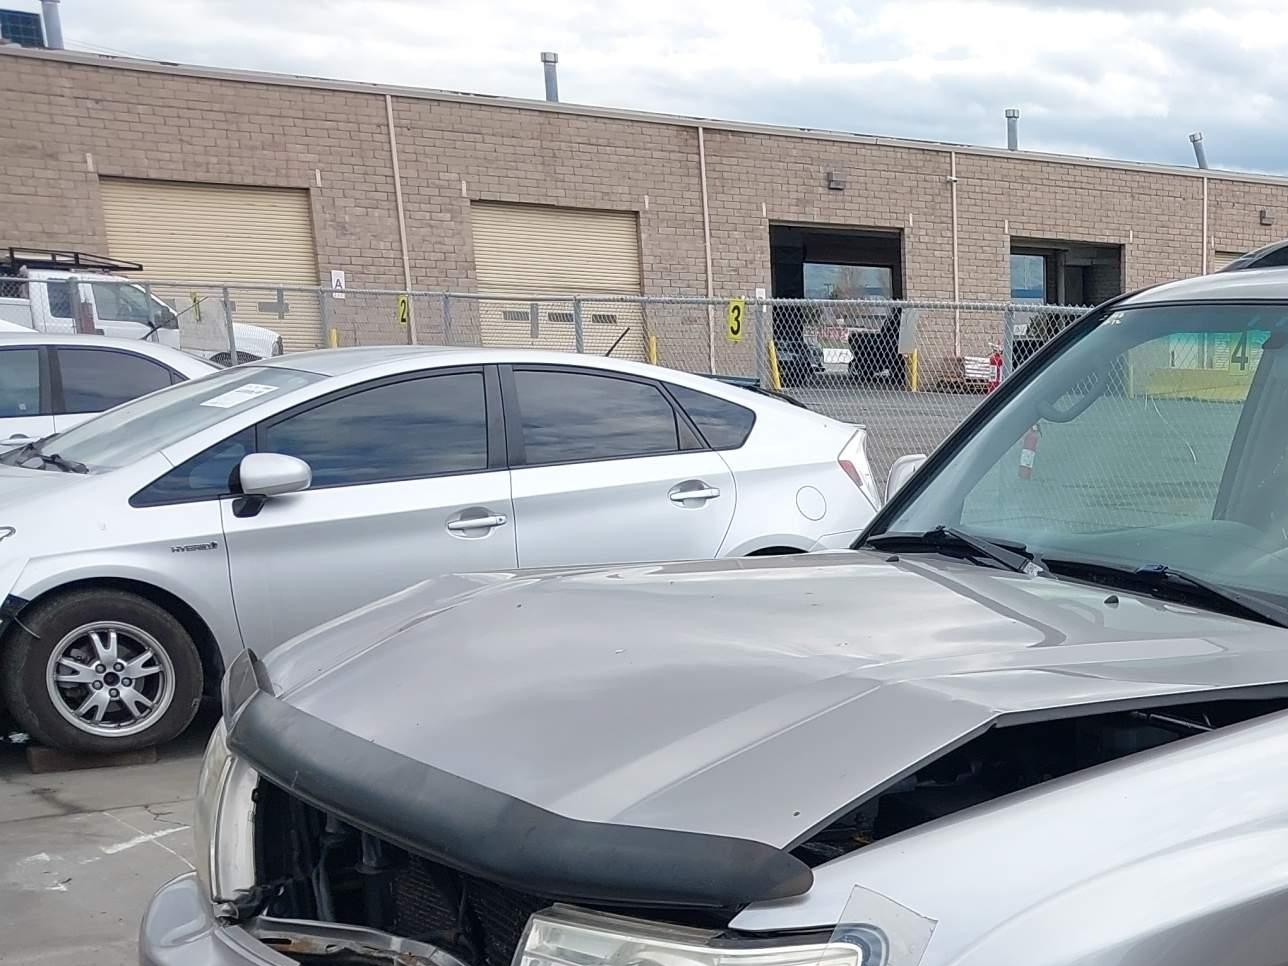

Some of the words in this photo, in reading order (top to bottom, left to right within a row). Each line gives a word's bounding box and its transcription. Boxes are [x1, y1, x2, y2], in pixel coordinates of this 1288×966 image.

[334, 278, 343, 289] A
[400, 299, 407, 323] 2
[730, 304, 741, 335] 3
[1230, 331, 1249, 371] 4
